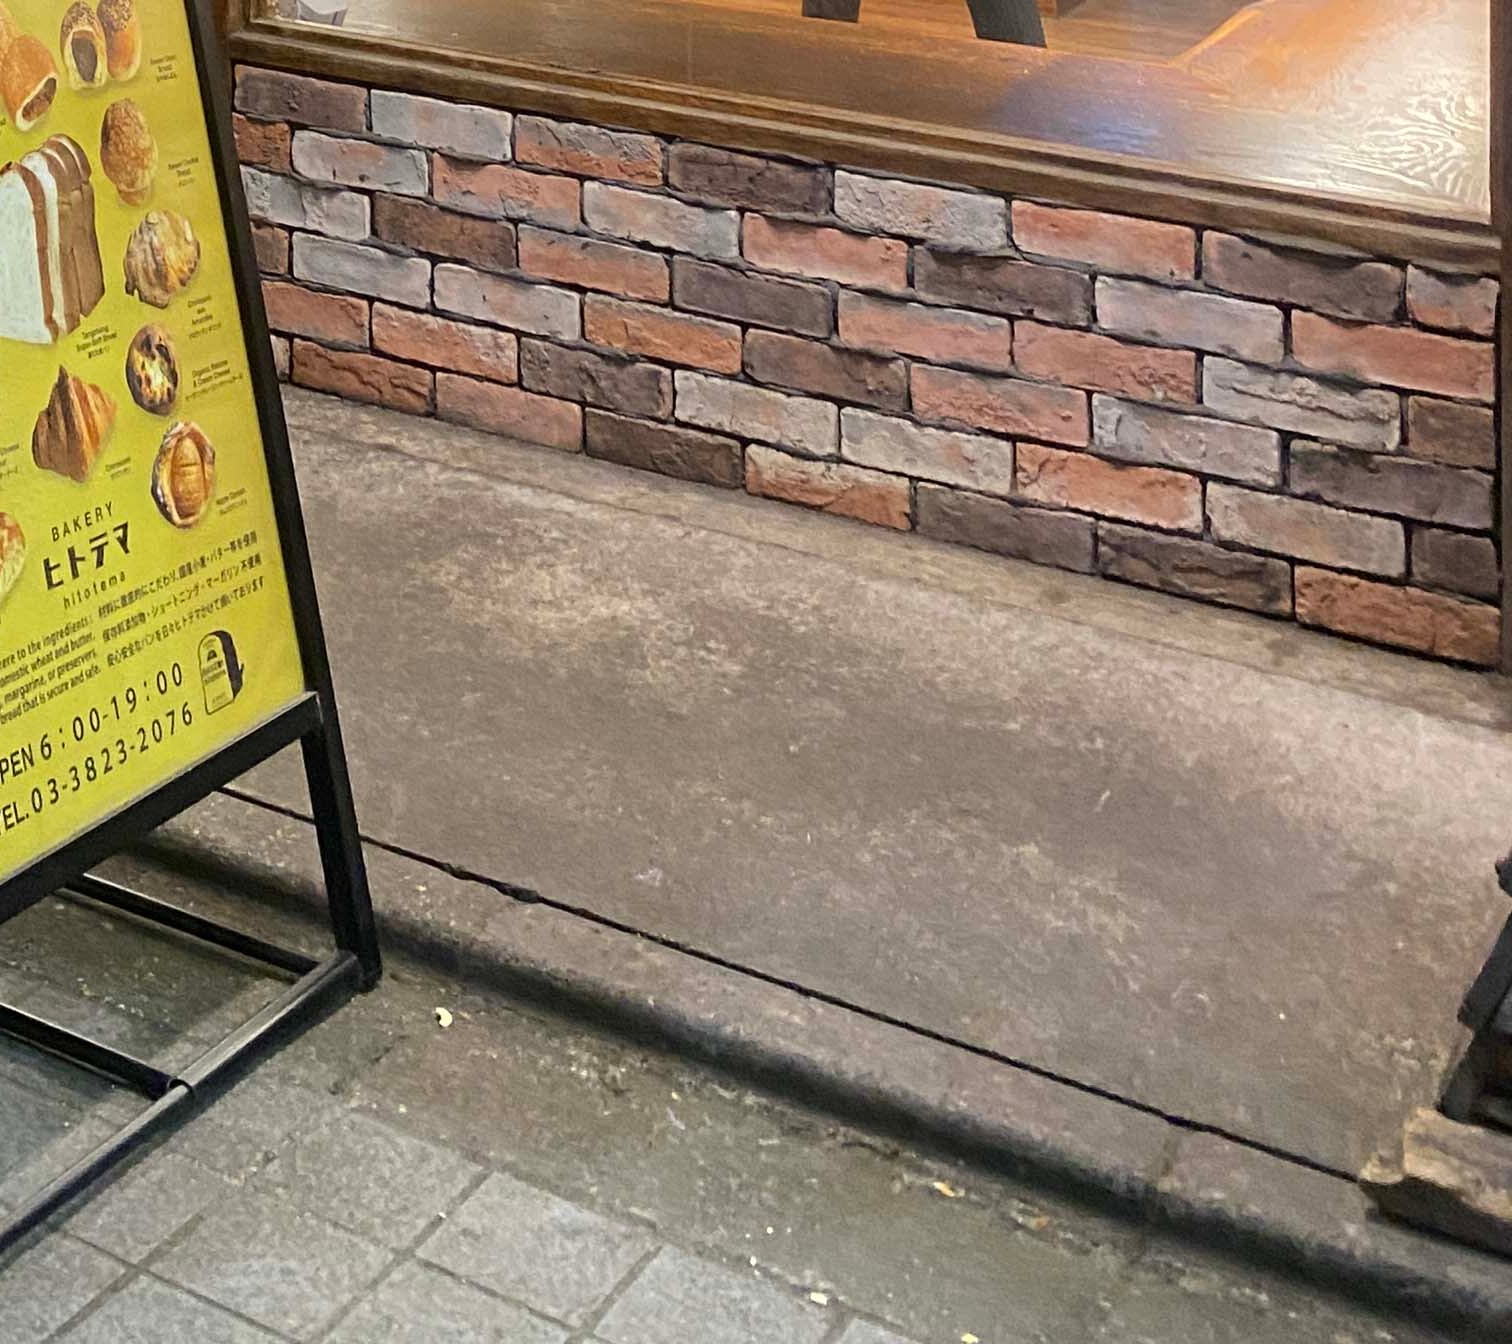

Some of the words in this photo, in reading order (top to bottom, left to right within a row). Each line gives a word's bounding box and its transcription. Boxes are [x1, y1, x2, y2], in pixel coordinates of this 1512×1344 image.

[51, 500, 115, 543] BAKERY
[43, 521, 131, 591] ヒトテマ
[63, 571, 127, 610] hitotema
[16, 645, 26, 662] to
[27, 637, 41, 656] the
[54, 641, 69, 660] and
[69, 670, 84, 688] and
